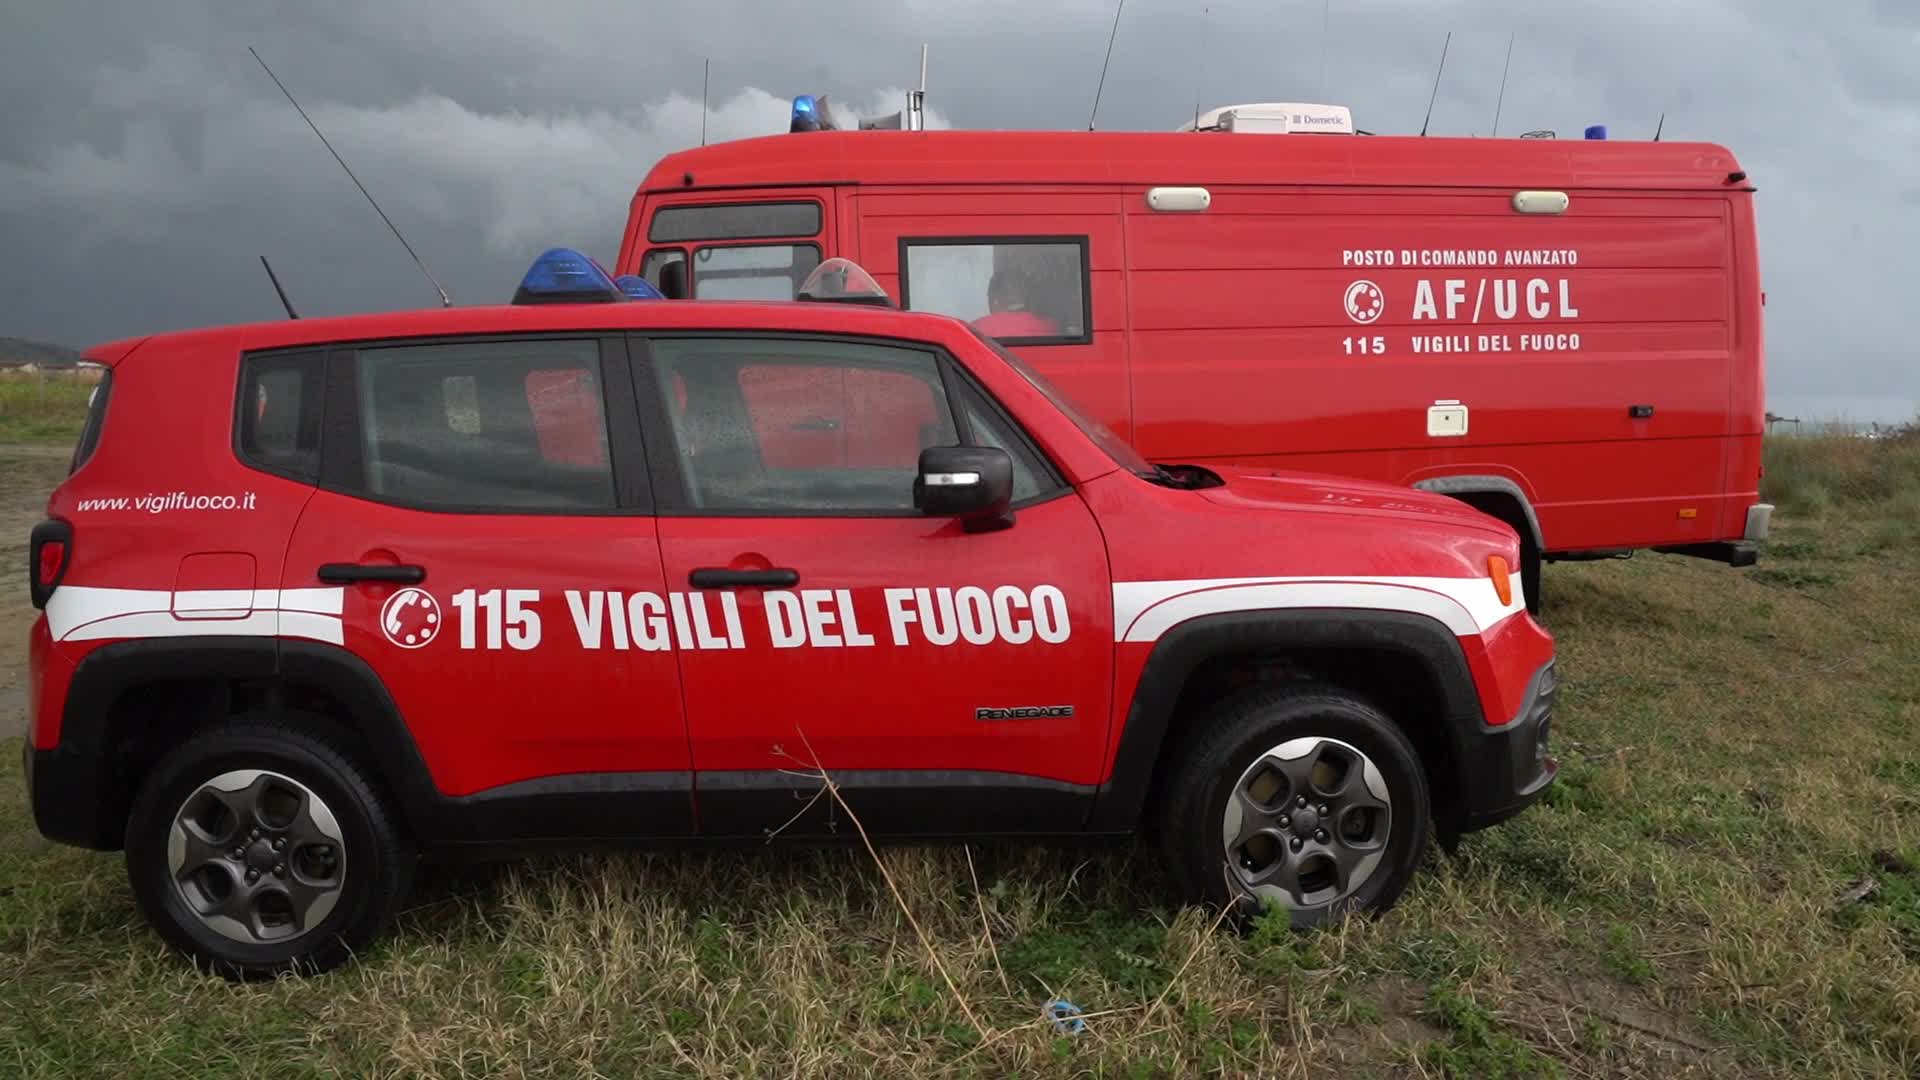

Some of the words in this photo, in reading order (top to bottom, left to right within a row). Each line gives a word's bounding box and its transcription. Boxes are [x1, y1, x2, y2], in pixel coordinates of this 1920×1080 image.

[1304, 115, 1344, 125] Dometic
[1343, 250, 1395, 266] POSTO
[1401, 250, 1417, 266] DI
[1421, 250, 1497, 266] COMANDO
[1504, 250, 1578, 265] AVANZATO
[1412, 278, 1579, 324] AF/UCL
[1342, 336, 1386, 355] 115
[1411, 335, 1470, 352] VIGILI
[1478, 335, 1512, 352] DEL
[1520, 334, 1580, 351] FUOCO
[77, 492, 257, 513] www.vigilfuoco.it
[452, 588, 542, 651] 115
[564, 590, 746, 651] VIGILI
[763, 588, 876, 649] DEL
[884, 585, 1072, 646] FUOCO
[976, 705, 1074, 720] RENEGADE
